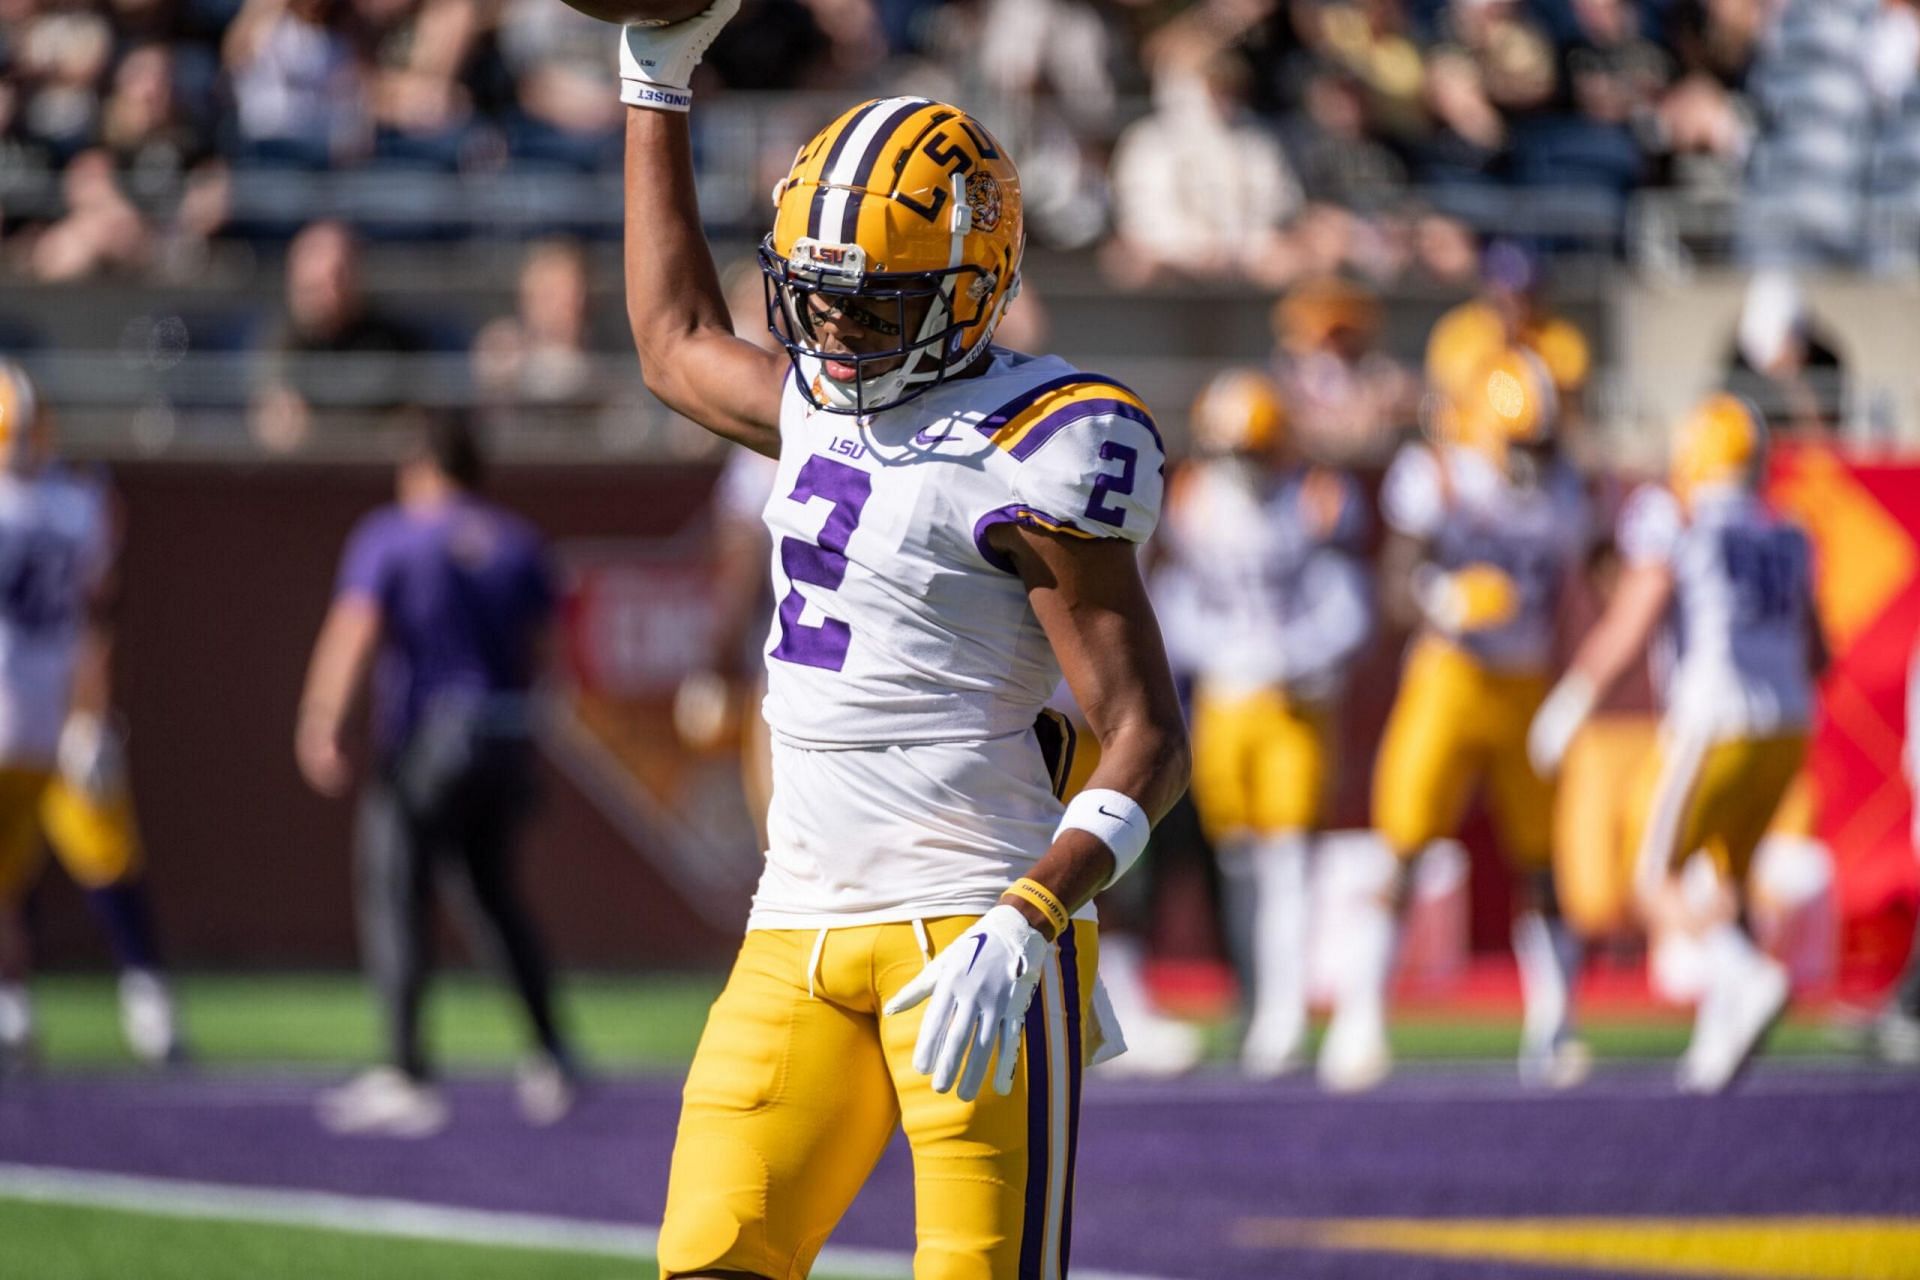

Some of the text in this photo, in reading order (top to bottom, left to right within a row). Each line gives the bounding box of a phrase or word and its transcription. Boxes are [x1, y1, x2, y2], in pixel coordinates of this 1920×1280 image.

[896, 121, 999, 223] LSU
[809, 245, 846, 264] LSU
[828, 436, 867, 460] LSU
[1084, 440, 1138, 528] 2
[768, 453, 872, 673] 2
